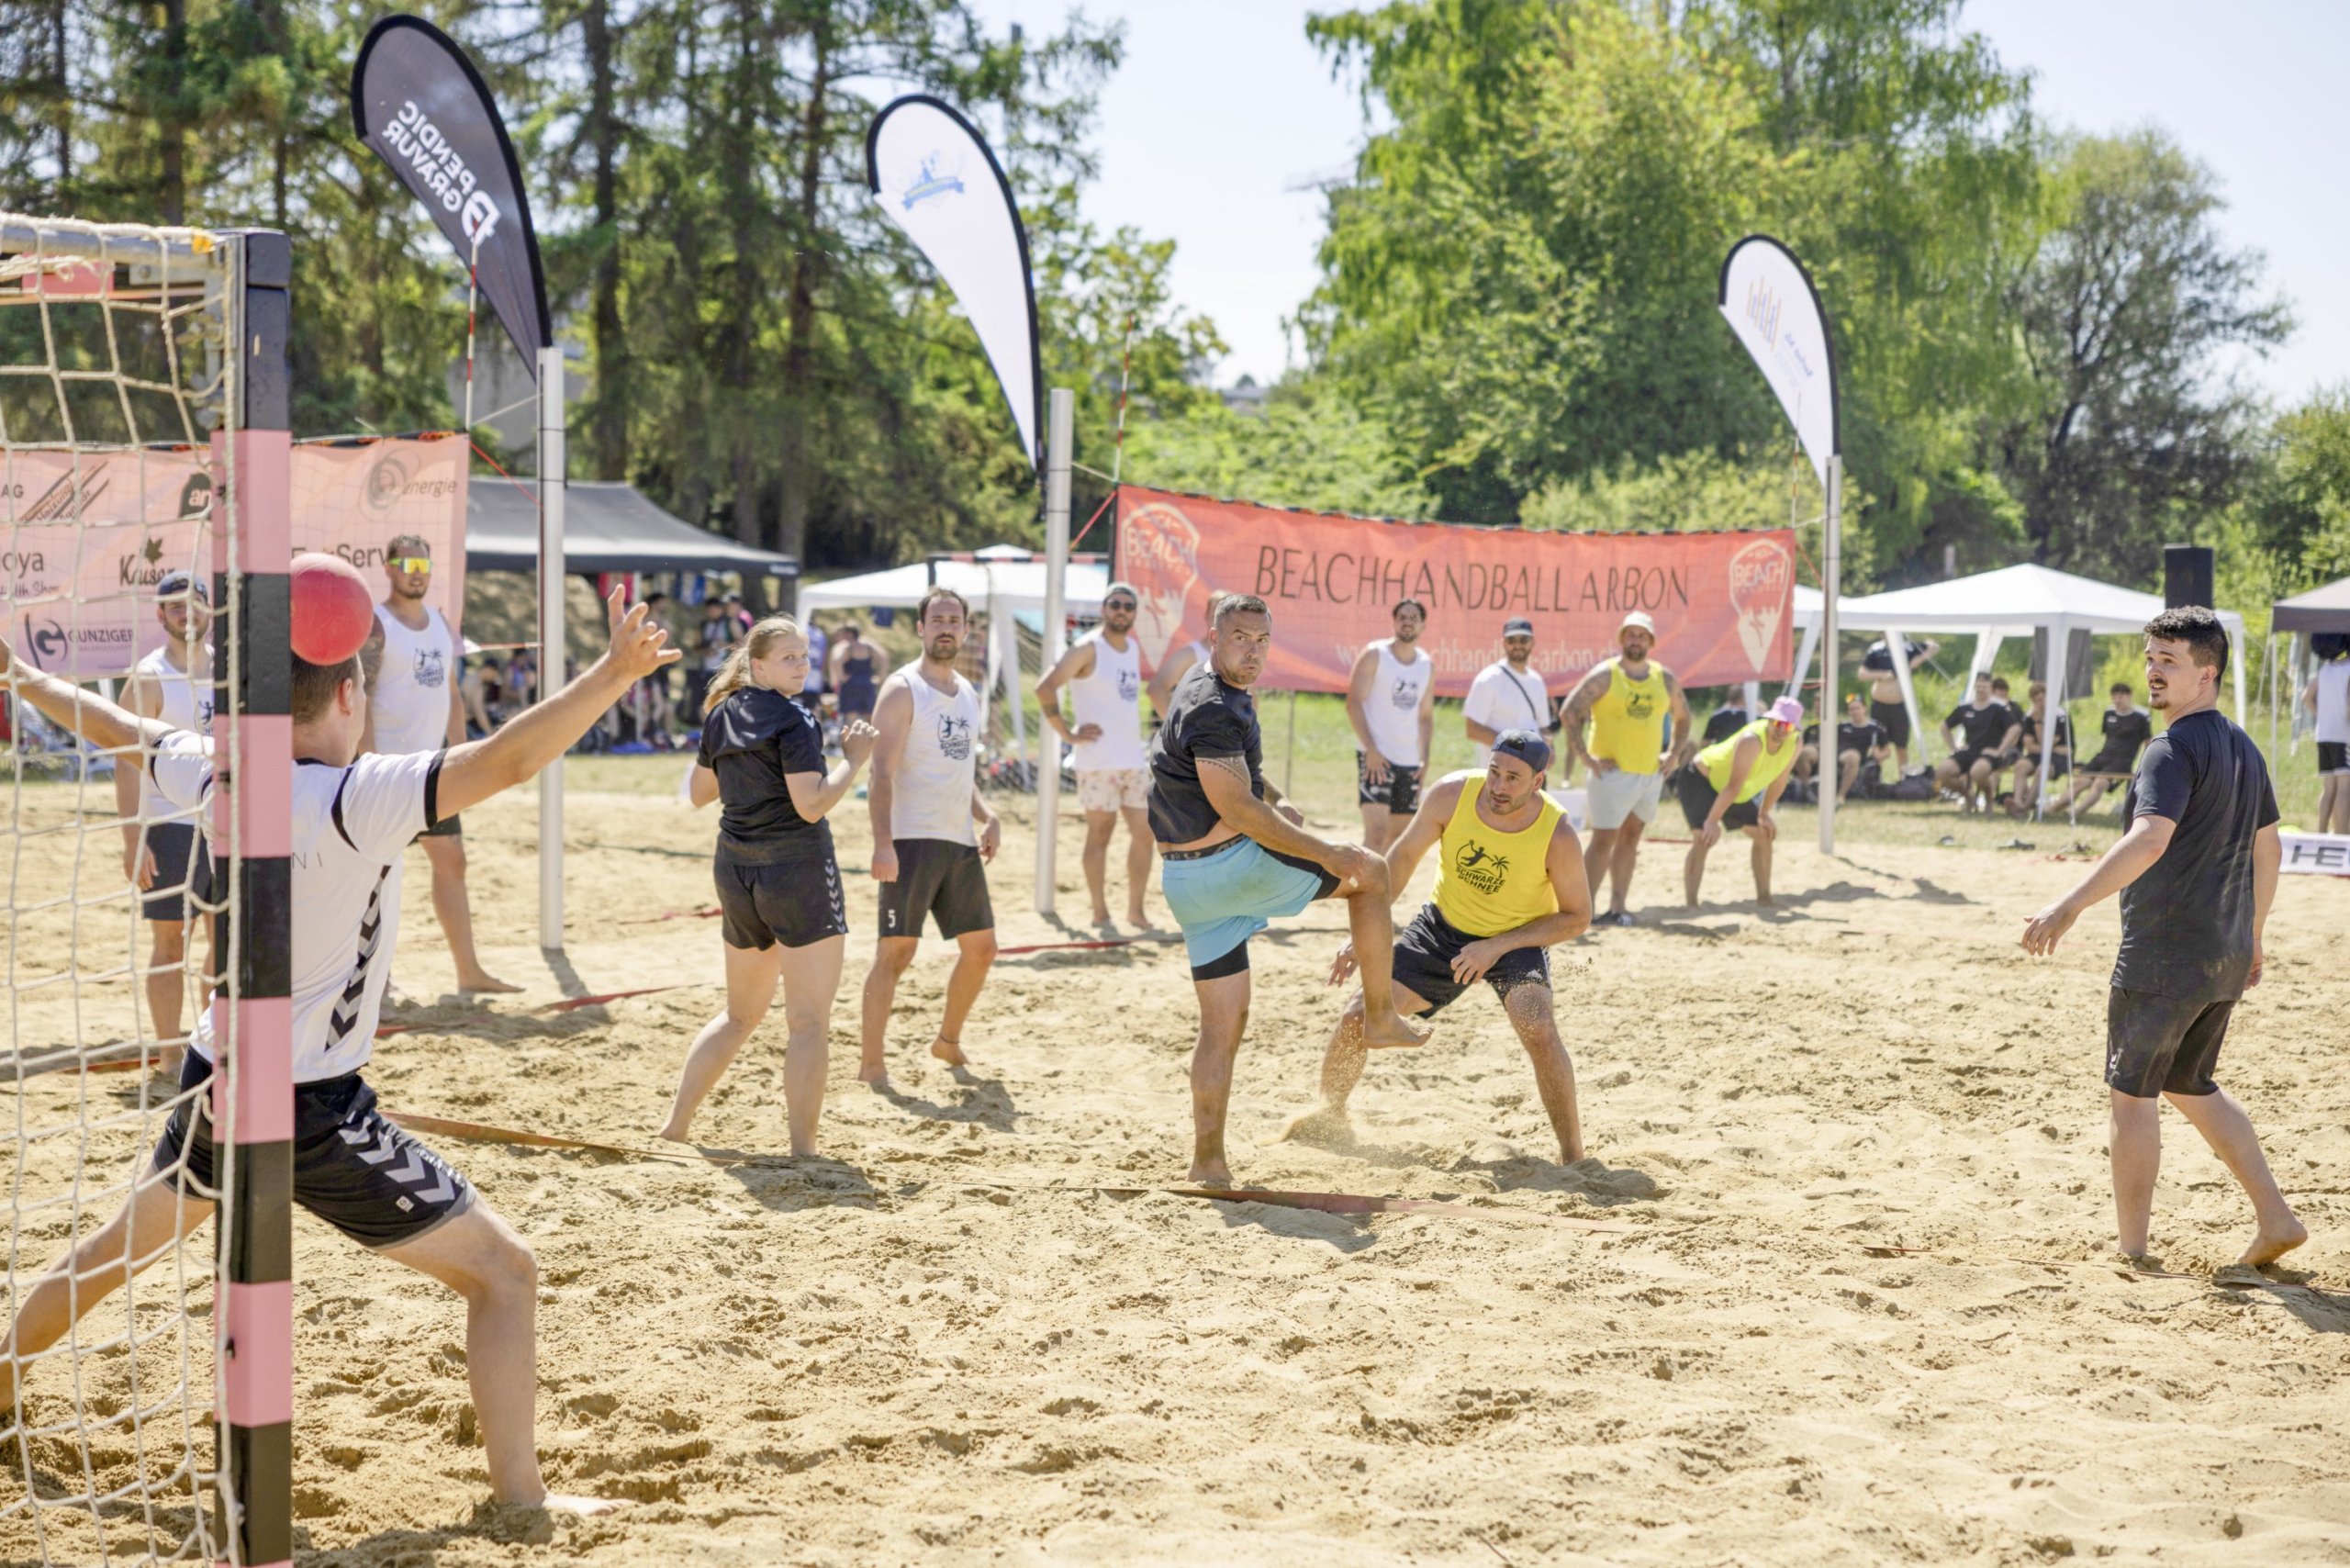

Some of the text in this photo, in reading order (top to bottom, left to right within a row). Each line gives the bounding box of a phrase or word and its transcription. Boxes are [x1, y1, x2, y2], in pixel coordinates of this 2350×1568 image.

[1255, 545, 1689, 612] BEACHHANDBALL ARBON
[1734, 561, 1786, 588] BEACH
[1456, 866, 1506, 886] SCHWARZE
[1458, 875, 1502, 893] SCHNEE
[888, 910, 896, 928] 5
